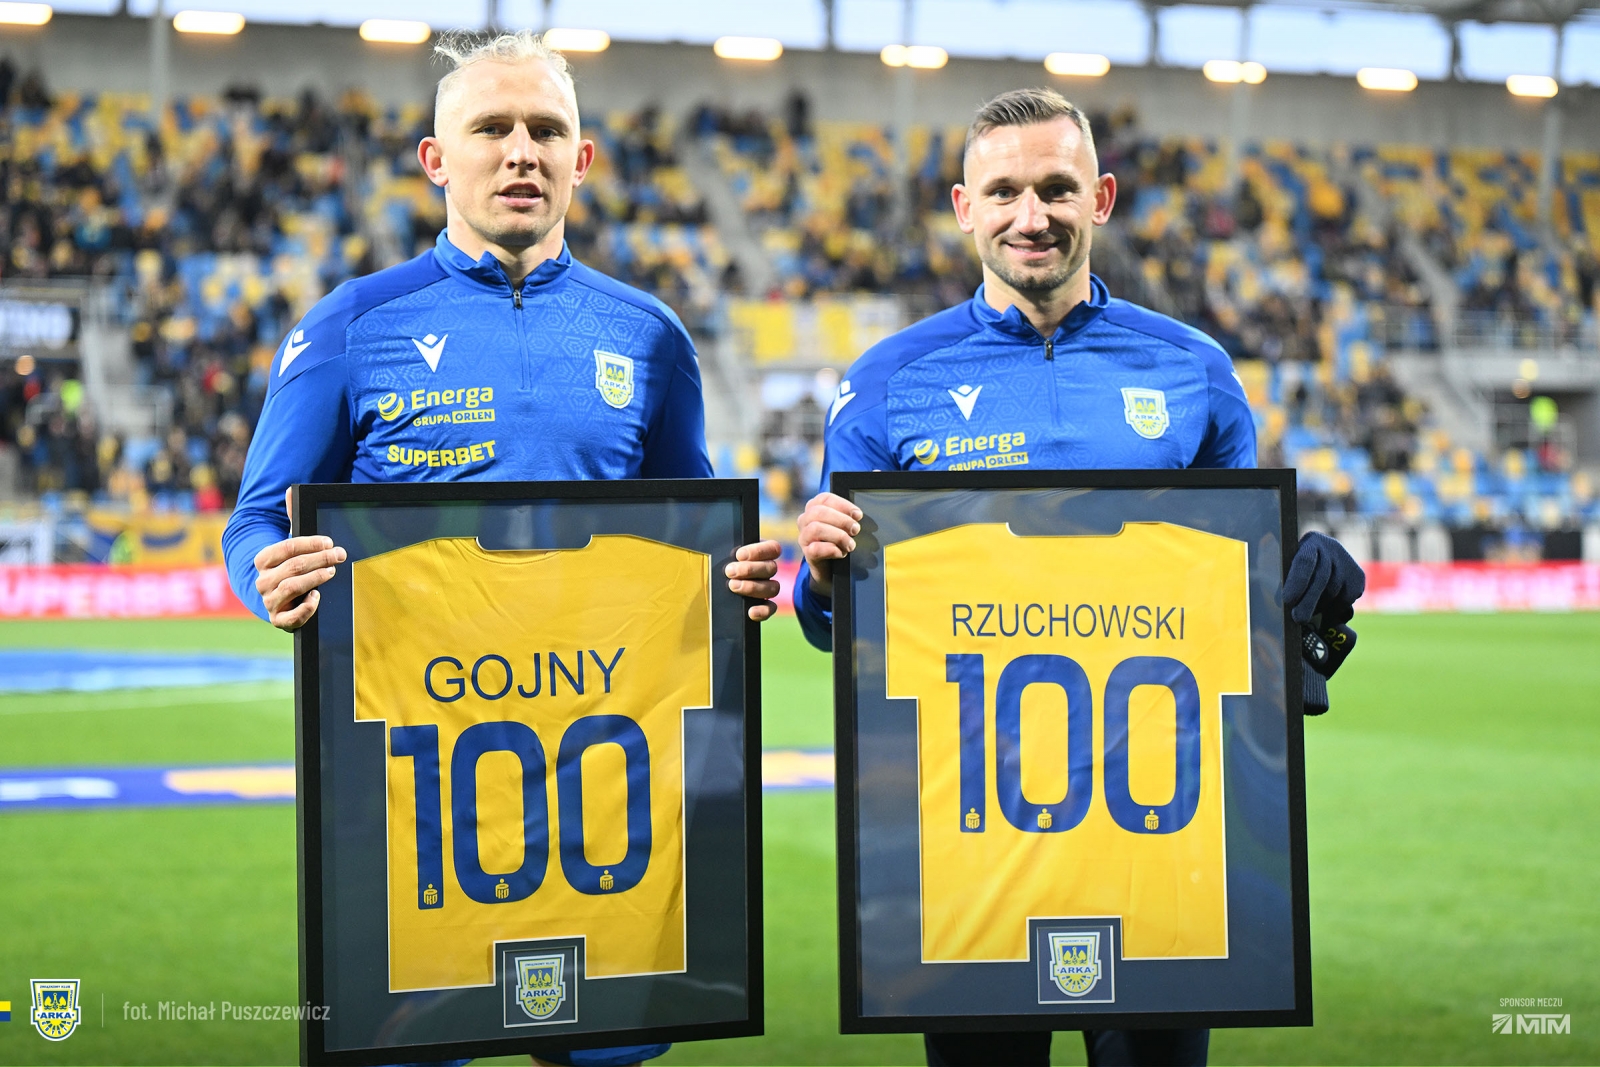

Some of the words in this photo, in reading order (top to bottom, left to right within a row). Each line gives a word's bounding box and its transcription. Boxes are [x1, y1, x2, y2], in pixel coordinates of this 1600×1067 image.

[411, 387, 494, 410] Energa
[413, 414, 452, 427] GRUPA
[455, 411, 492, 421] ORLEN
[387, 440, 496, 467] SUPERBET
[945, 432, 1026, 457] Energa
[948, 459, 986, 472] GRUPA
[989, 455, 1025, 466] ORLEN
[952, 603, 1185, 640] RZUCHOWSKI
[424, 647, 626, 703] GOJNY
[945, 653, 1201, 834] 100
[390, 714, 652, 910] 100
[526, 989, 557, 997] ARKA
